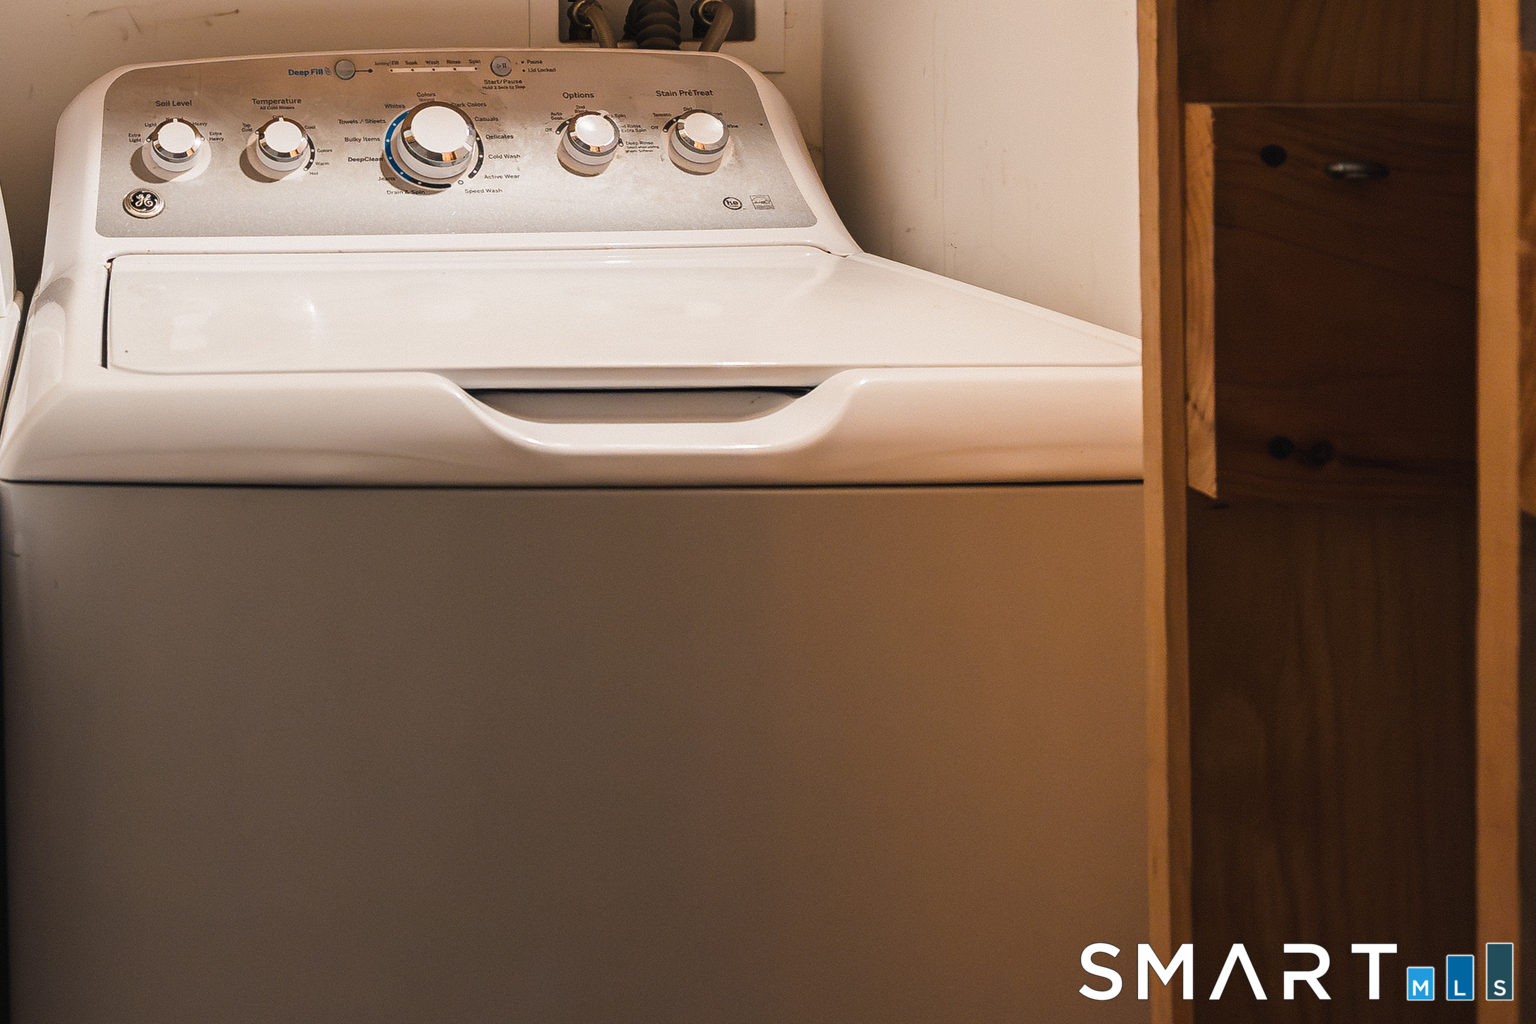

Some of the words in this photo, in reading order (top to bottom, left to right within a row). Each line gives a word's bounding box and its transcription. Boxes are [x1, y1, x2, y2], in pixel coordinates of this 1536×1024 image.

[288, 68, 310, 77] Deep
[310, 68, 324, 76] Fill
[562, 91, 595, 100] Options
[655, 89, 678, 97] Stain
[172, 99, 192, 107] Level
[251, 97, 302, 106] Temperature
